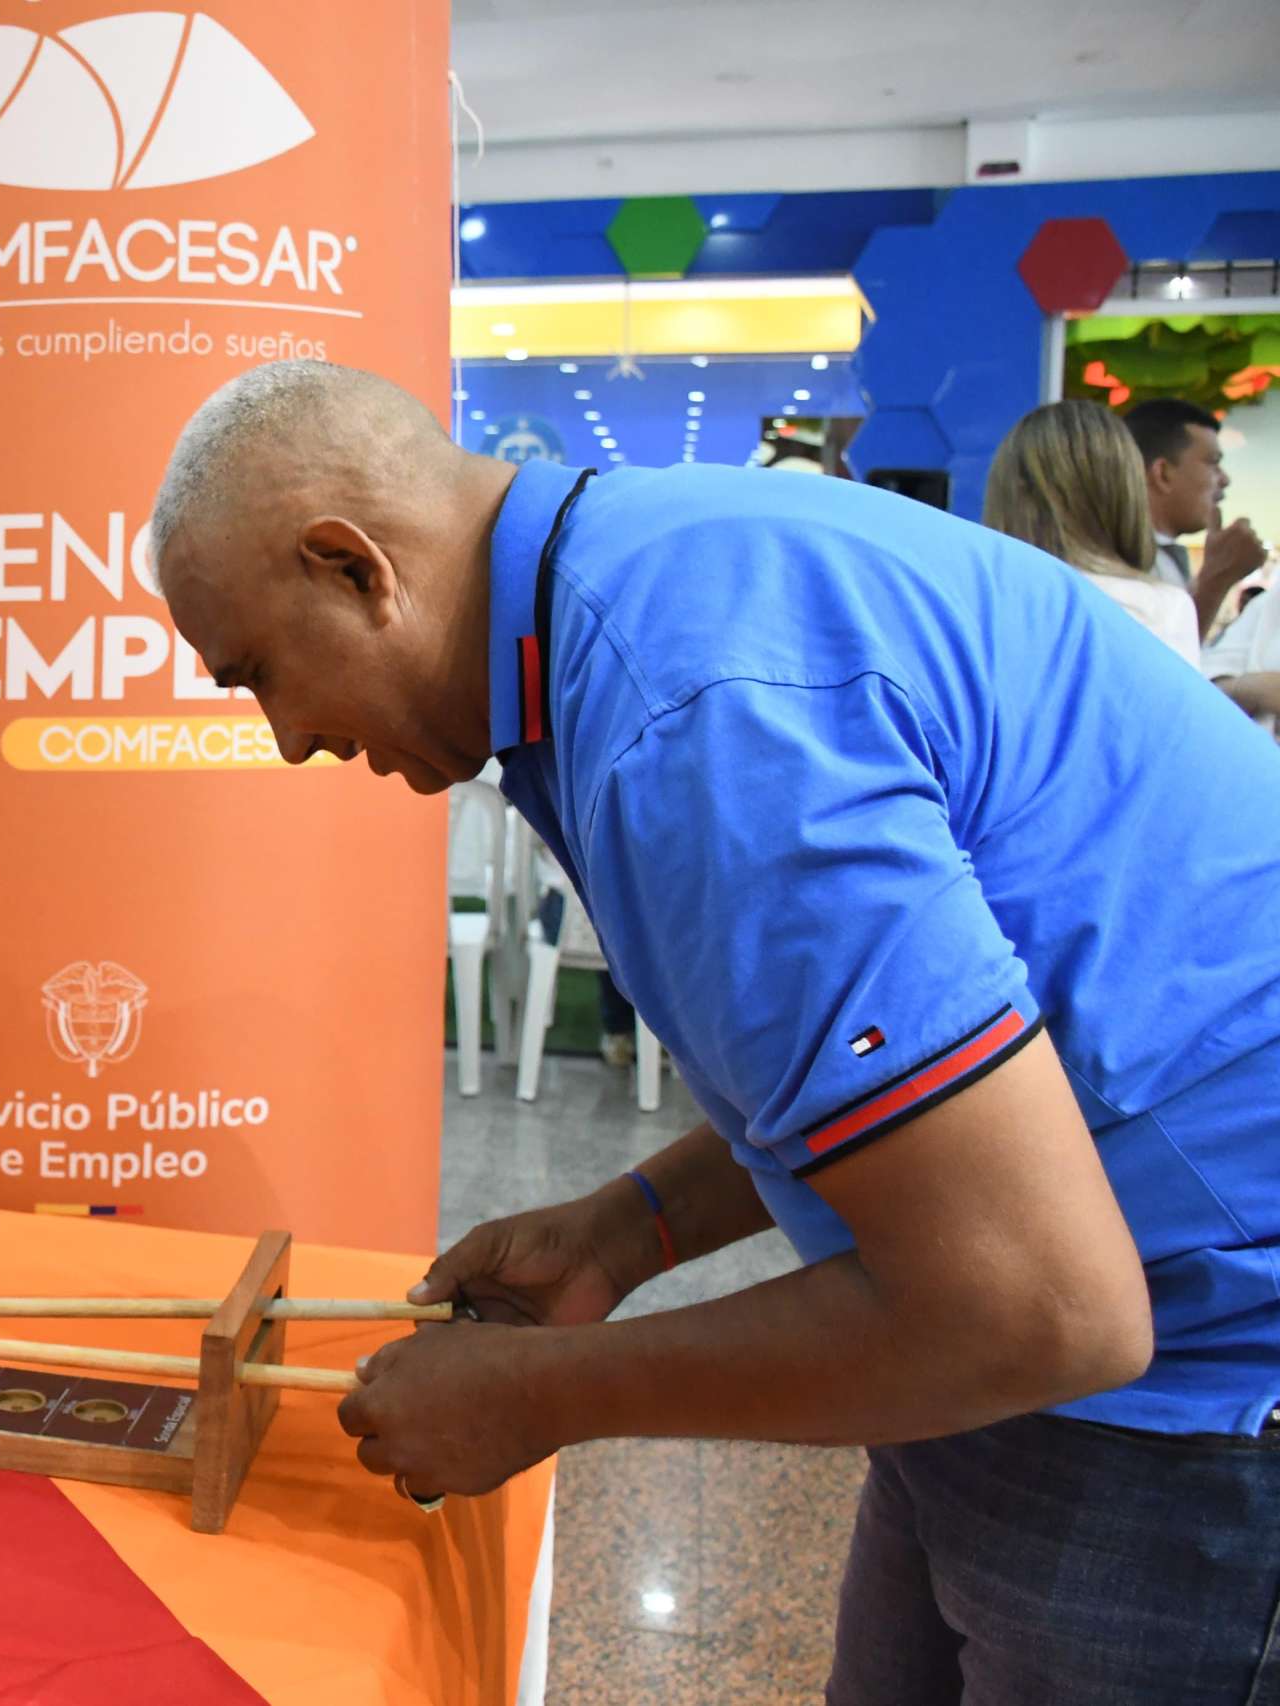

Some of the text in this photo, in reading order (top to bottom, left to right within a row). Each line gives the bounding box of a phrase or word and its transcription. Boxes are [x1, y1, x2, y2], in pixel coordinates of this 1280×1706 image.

[16, 320, 213, 362] cumpliendo
[225, 330, 326, 361] sueños
[38, 722, 282, 764] COMFACES
[107, 1090, 269, 1132] Público
[40, 1141, 207, 1188] Empleo
